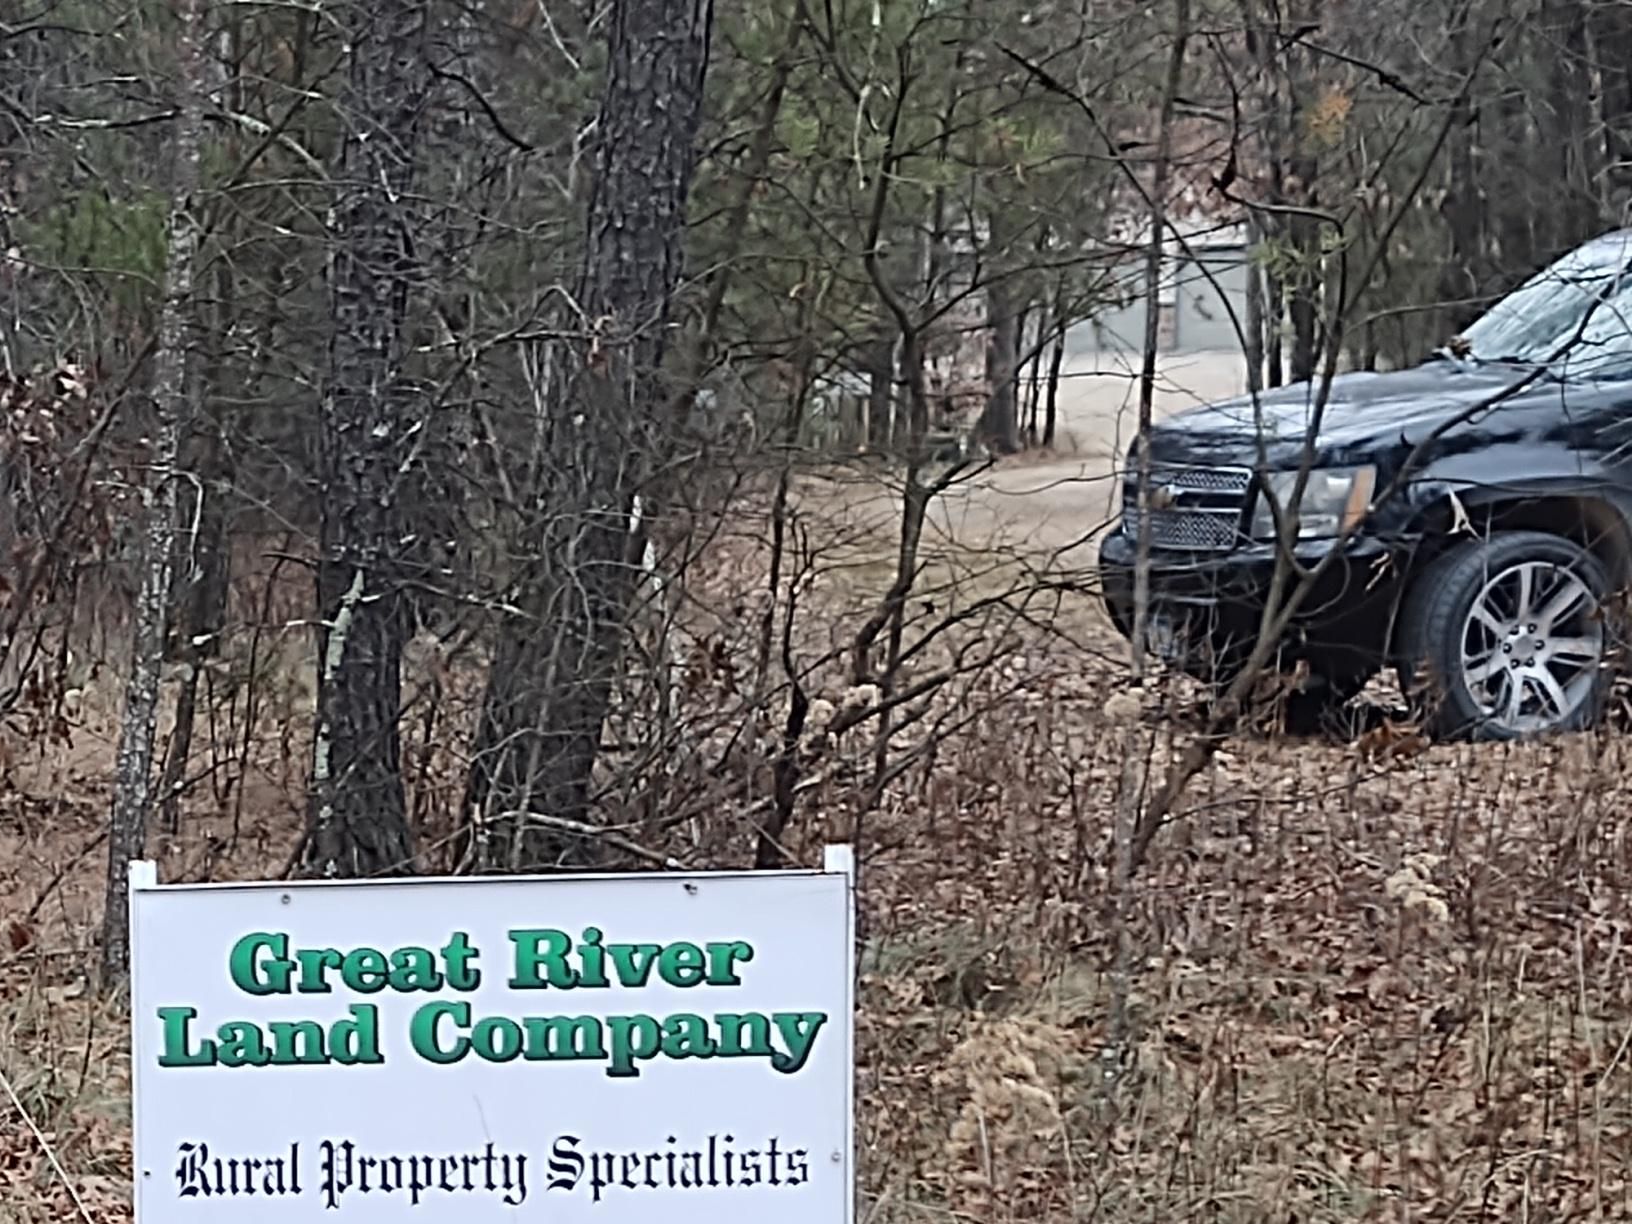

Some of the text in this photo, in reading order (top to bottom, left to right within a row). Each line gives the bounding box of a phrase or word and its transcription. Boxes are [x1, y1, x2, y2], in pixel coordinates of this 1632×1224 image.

[228, 926, 755, 997] Great River
[156, 1000, 829, 1078] Land Company
[174, 1133, 810, 1210] Rural Property Specialists
